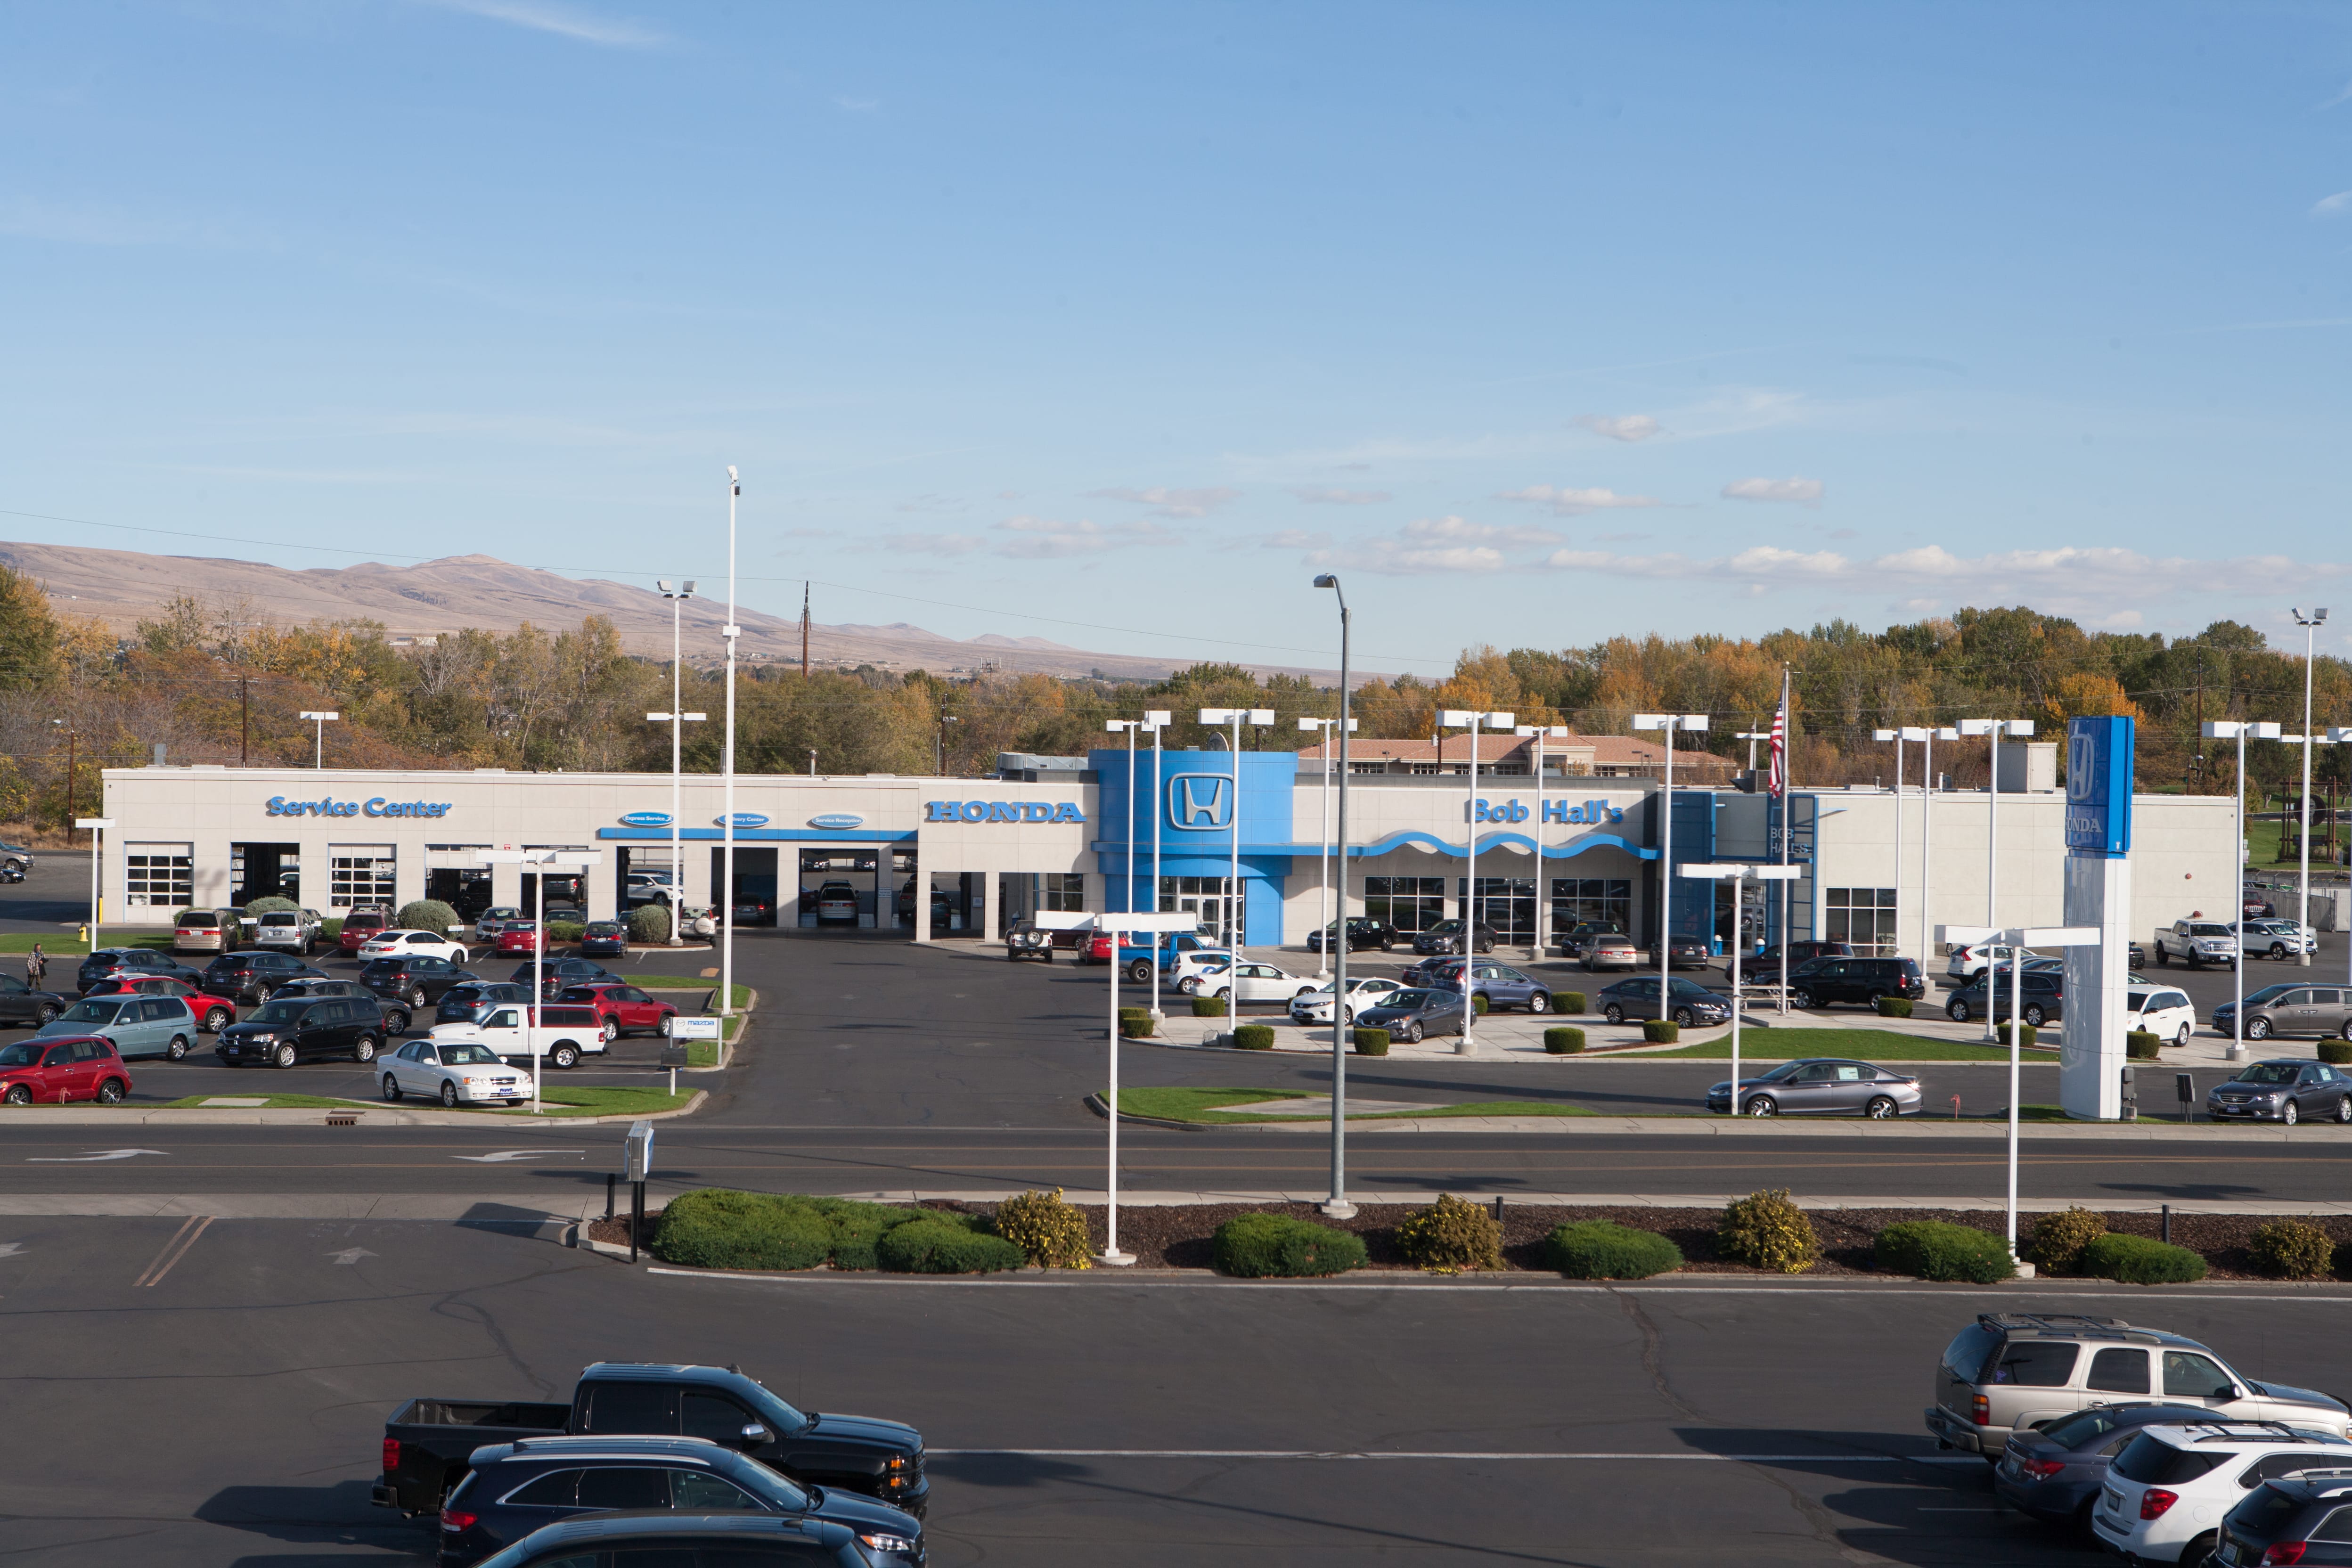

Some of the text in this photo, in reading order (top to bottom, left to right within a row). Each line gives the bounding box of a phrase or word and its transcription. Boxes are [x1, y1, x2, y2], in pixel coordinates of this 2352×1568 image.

[270, 796, 452, 816] Service Center
[930, 800, 1087, 822] HONDA
[1475, 799, 1624, 823] Bob Hall's
